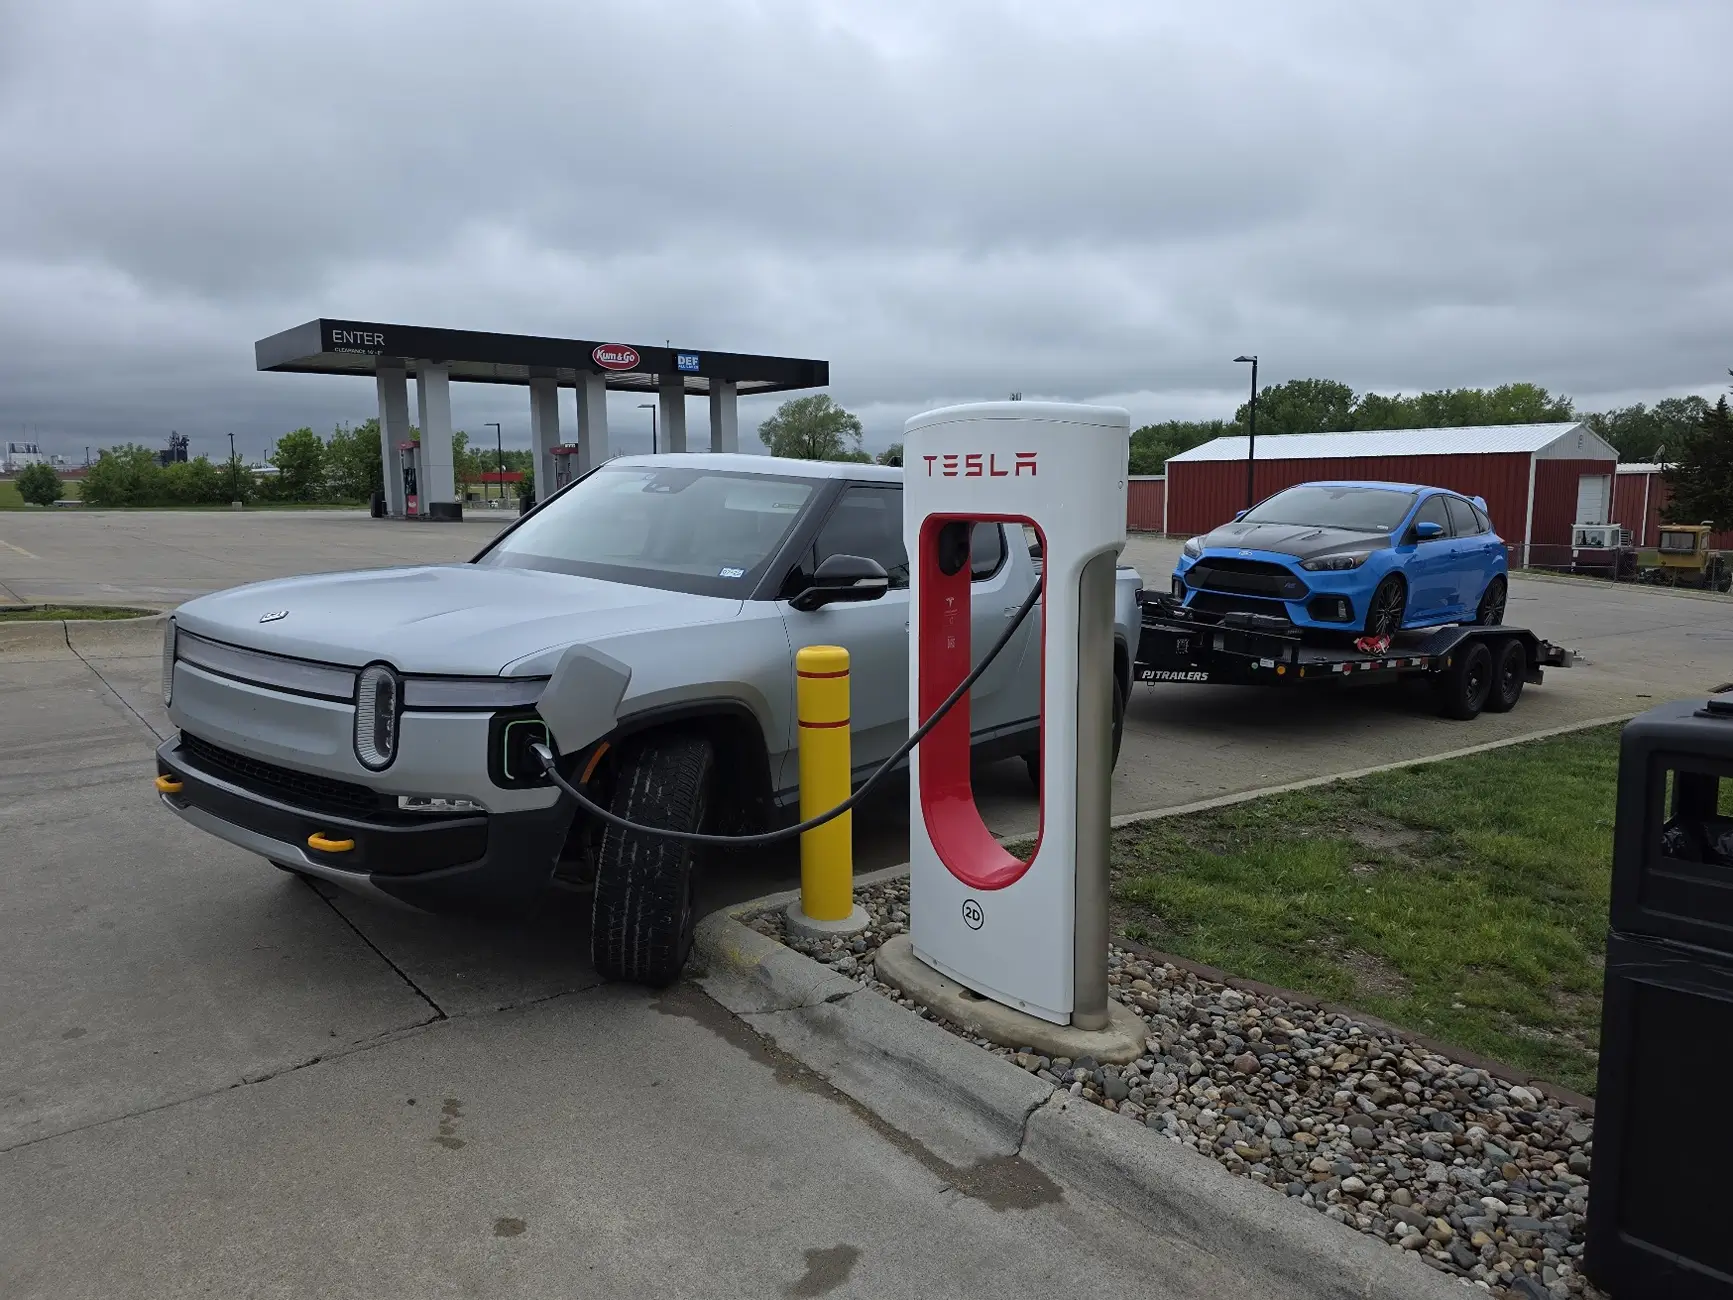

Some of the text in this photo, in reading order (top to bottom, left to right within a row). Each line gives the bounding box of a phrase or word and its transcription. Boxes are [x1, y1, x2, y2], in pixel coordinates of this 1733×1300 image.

[332, 329, 386, 346] ENTER
[597, 350, 616, 361] Kum
[624, 352, 635, 363] Go
[677, 355, 699, 366] DEF
[923, 452, 1038, 477] TESLA
[1155, 670, 1209, 681] TRAILERS
[965, 906, 980, 922] 2D
